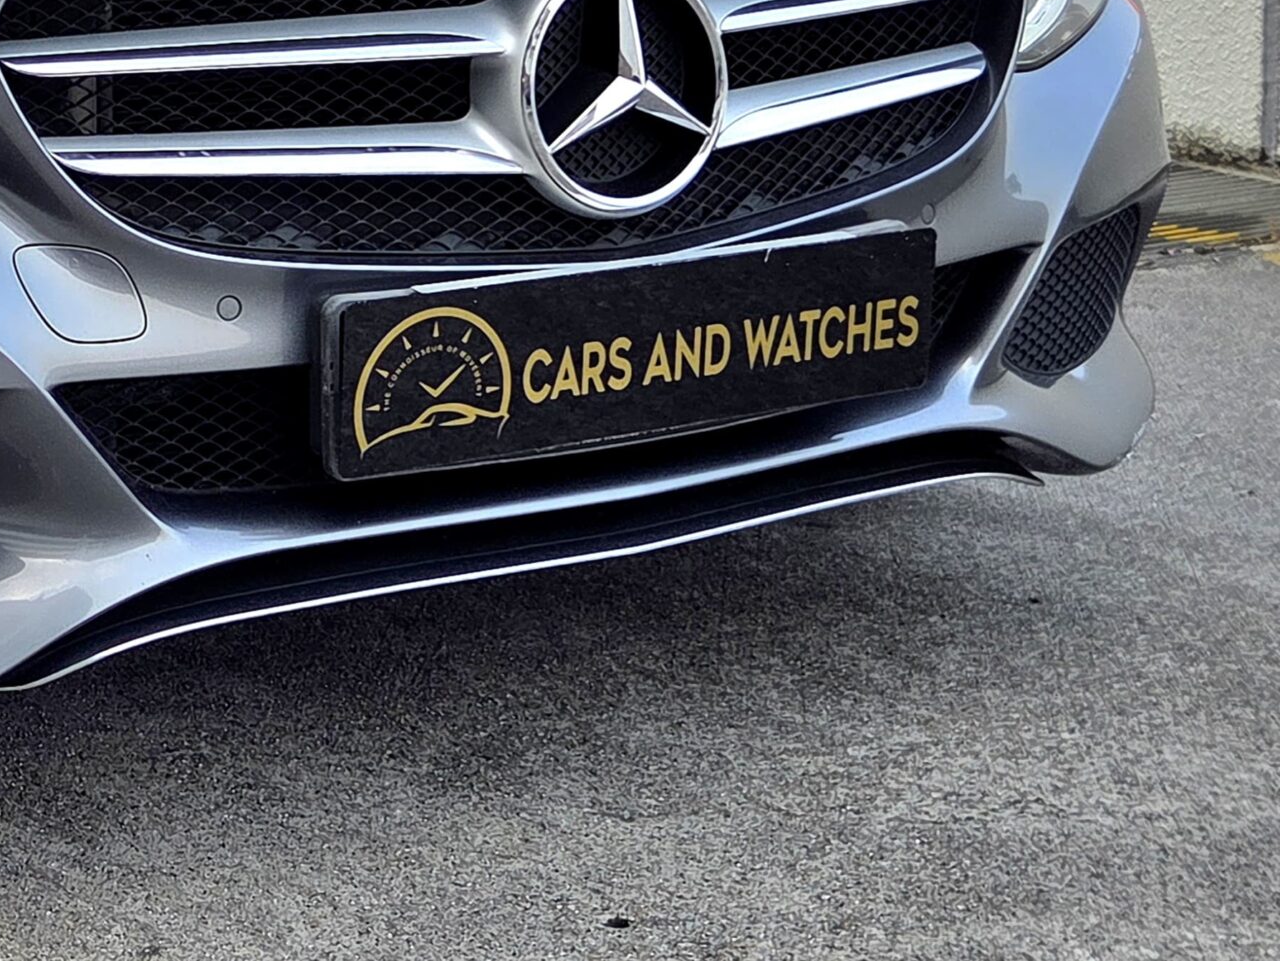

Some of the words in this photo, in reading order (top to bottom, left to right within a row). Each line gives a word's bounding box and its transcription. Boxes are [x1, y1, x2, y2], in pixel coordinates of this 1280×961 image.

[523, 336, 632, 404] CARS
[642, 323, 731, 387] AND
[744, 295, 920, 371] WATCHES
